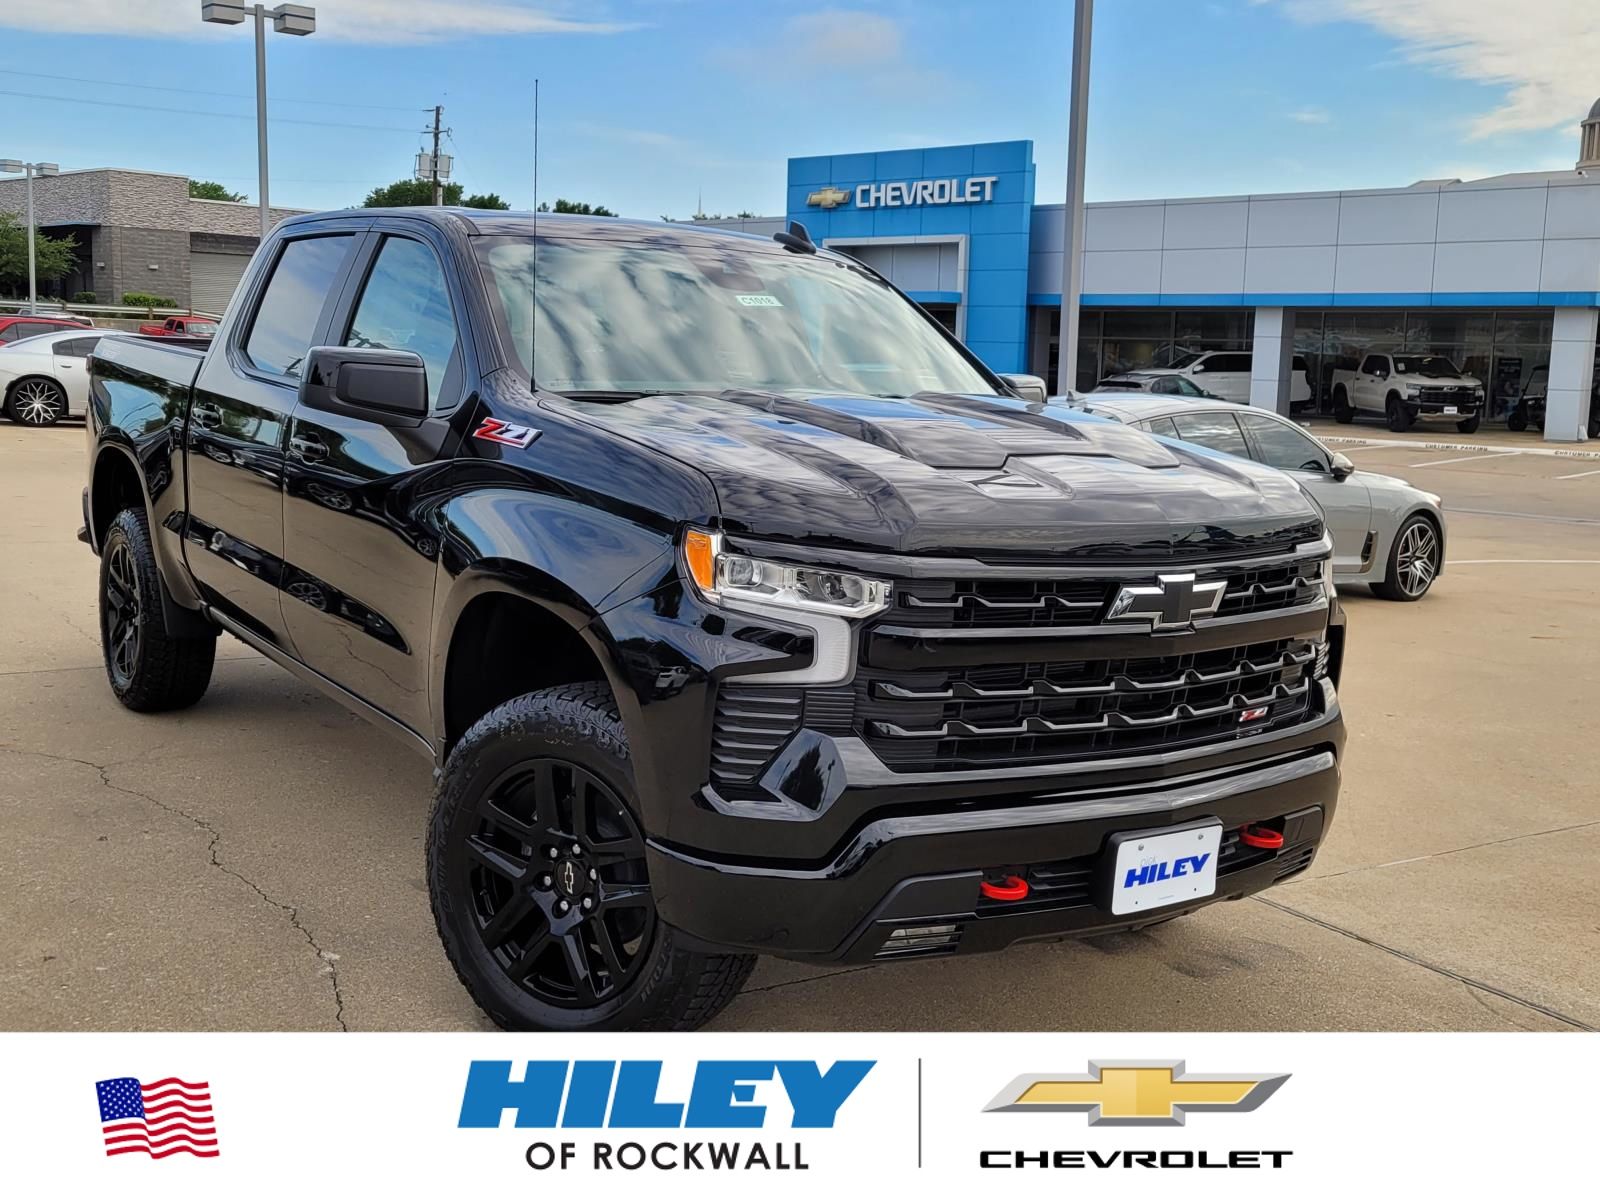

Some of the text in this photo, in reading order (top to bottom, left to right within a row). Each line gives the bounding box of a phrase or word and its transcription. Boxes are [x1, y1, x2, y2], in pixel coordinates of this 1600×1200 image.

[856, 176, 998, 208] CHEVROLET
[472, 416, 543, 450] Z71
[1124, 853, 1211, 888] HILEY
